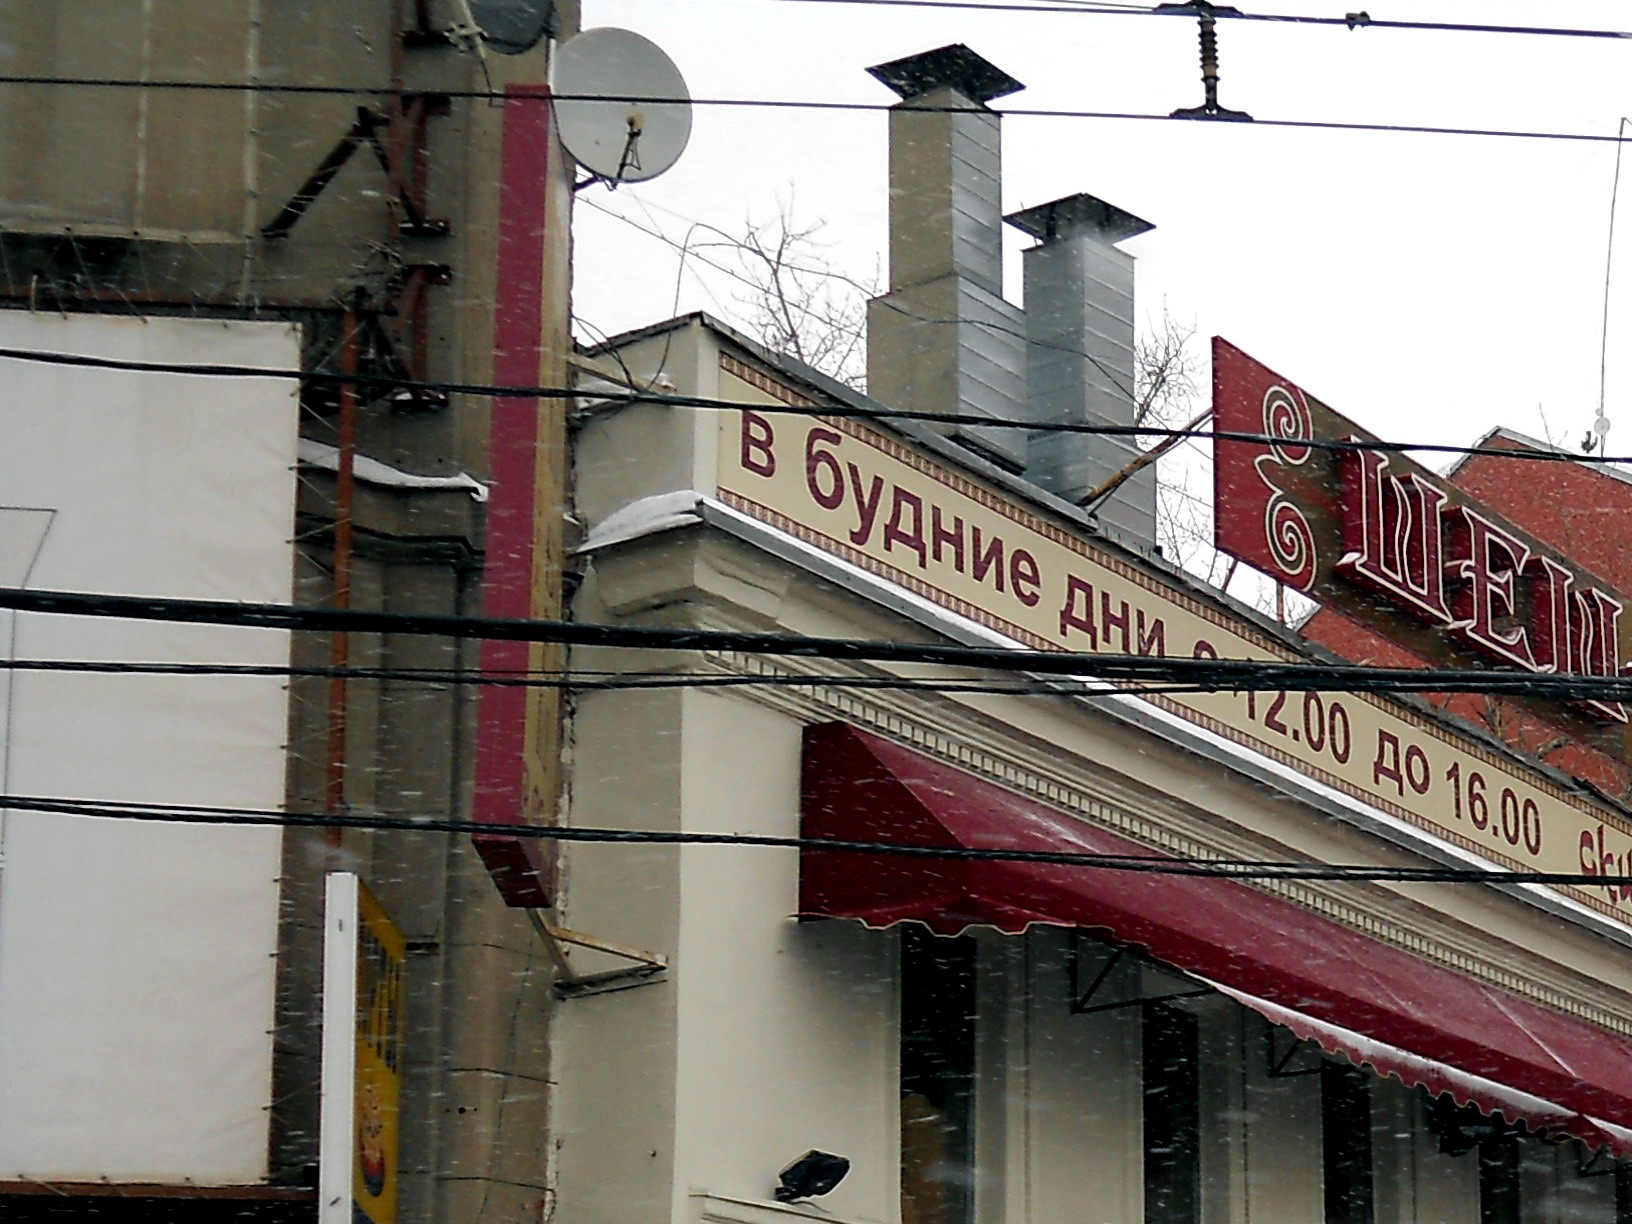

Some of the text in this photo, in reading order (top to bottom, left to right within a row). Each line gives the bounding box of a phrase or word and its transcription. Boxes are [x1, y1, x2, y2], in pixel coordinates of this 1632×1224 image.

[805, 426, 1043, 609] будние
[1058, 573, 1166, 660] дни
[1373, 727, 1432, 797] до
[1446, 760, 1542, 857] 16.00
